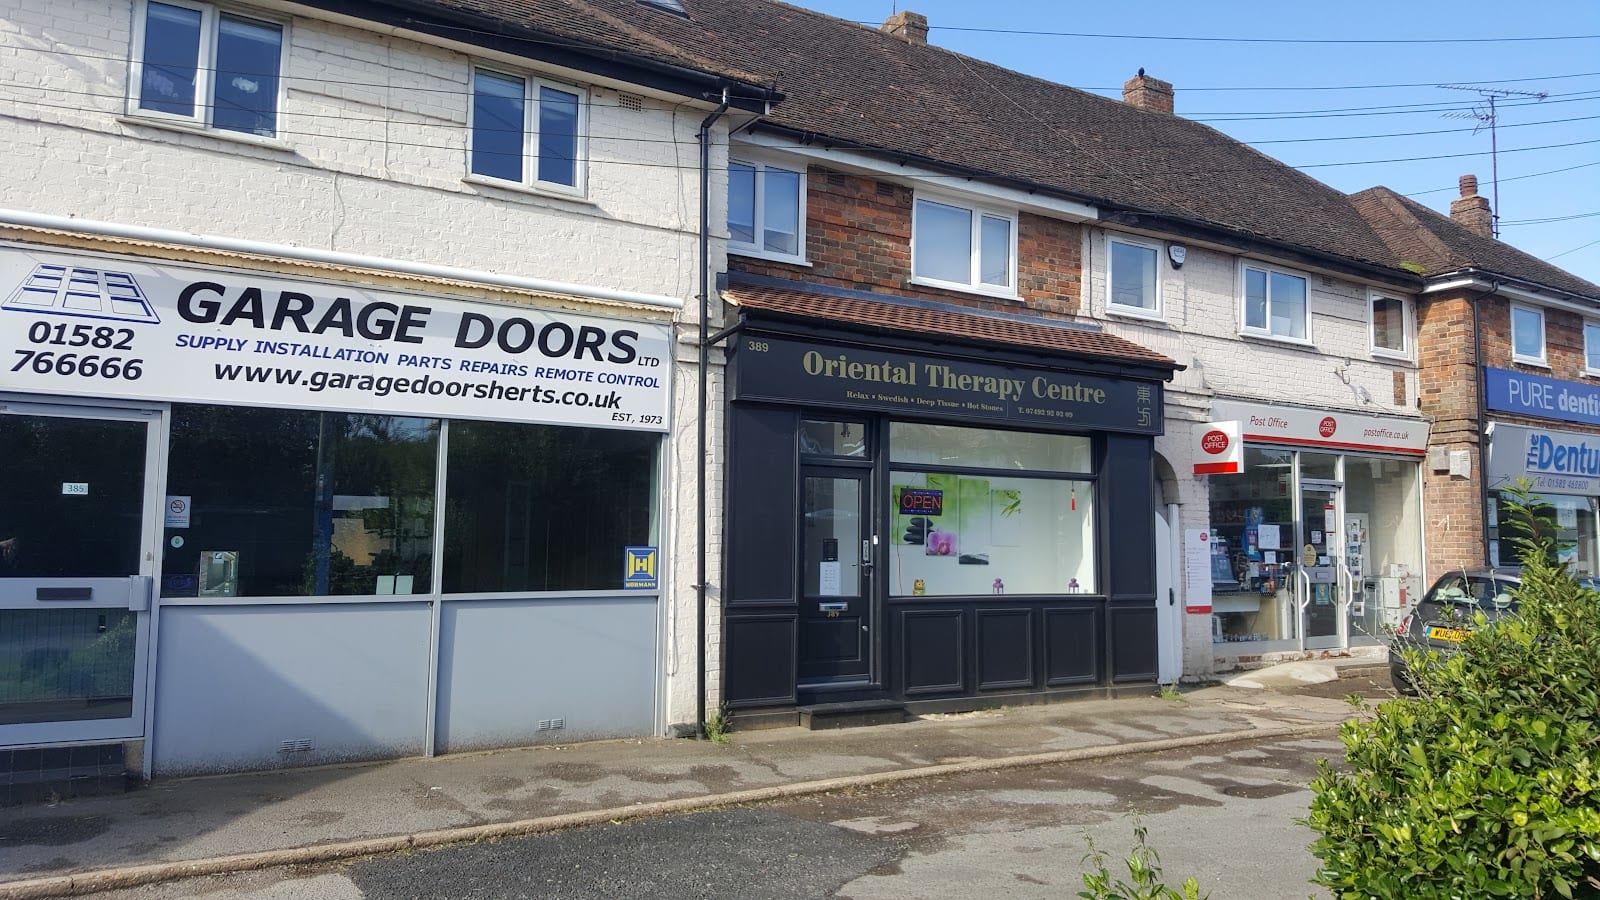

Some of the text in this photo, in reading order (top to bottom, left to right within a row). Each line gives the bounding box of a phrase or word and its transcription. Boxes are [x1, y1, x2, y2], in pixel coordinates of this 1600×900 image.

[28, 321, 136, 351] 01582
[177, 282, 660, 368] GARAGE DOORS LTD
[748, 340, 769, 353] 389
[10, 350, 144, 381] 766666
[175, 334, 660, 389] SUPPLY INSTALLATION PARTS REPAIRS REMOTE CONTROL
[214, 362, 622, 410] www.garagedoorsherts.co.uk
[803, 350, 1106, 404] Oriental Therapy Centre
[846, 390, 1004, 412] Relax Swedish Deep Tissue Hot Stones
[1508, 378, 1600, 416] PURE denti
[640, 414, 663, 425] 1973
[1249, 415, 1288, 429] Post Office
[1203, 441, 1227, 450] OFFICE
[1207, 434, 1224, 443] POST
[1363, 426, 1409, 441] postoffice.co.uk
[1527, 433, 1540, 469] The
[1538, 434, 1600, 476] Dentu
[67, 484, 85, 493] 385
[903, 494, 942, 510] OPEN
